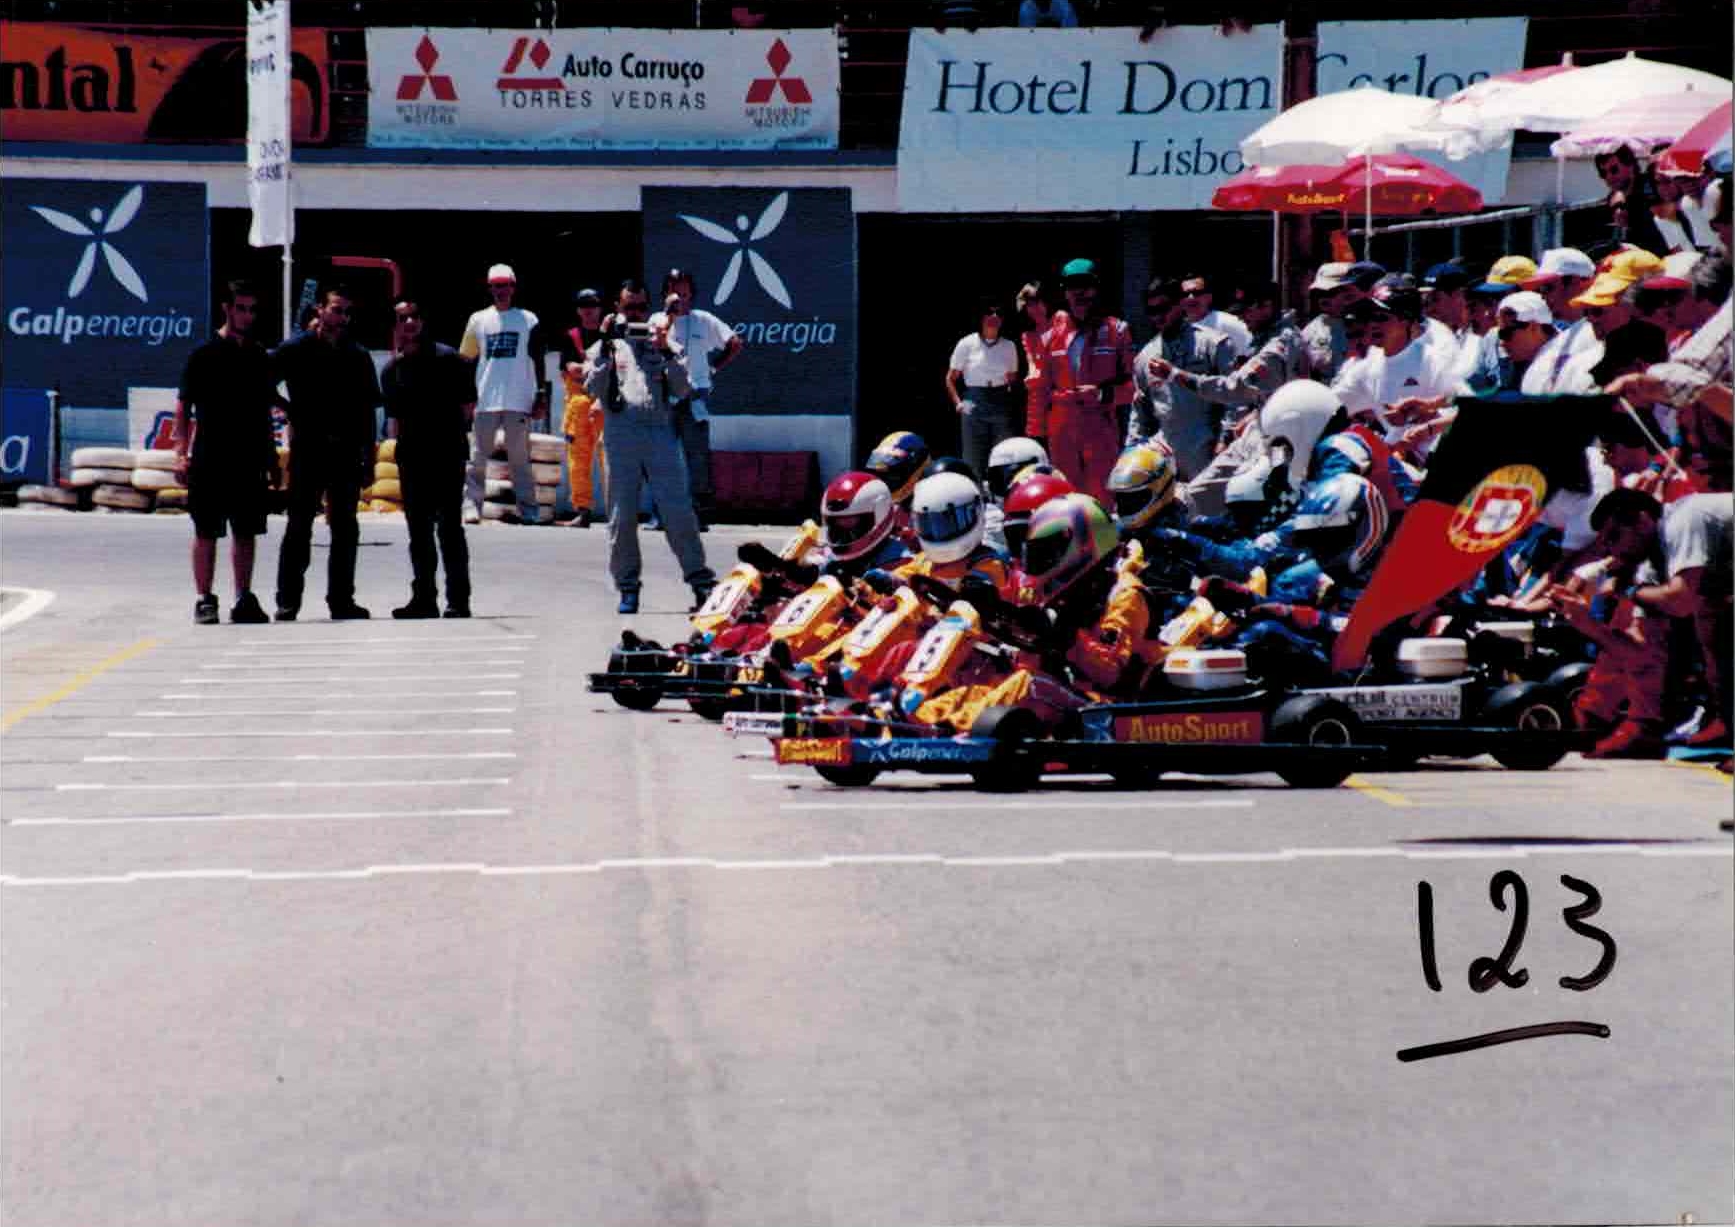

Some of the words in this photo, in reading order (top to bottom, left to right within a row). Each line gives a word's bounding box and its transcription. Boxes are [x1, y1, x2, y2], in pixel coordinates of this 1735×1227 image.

[0, 46, 137, 113] ntal
[563, 53, 613, 79] Auto
[620, 52, 705, 88] Carruço
[929, 59, 1091, 115] Hotel
[1116, 60, 1276, 115] Dom
[500, 90, 593, 109] TORRES
[612, 91, 706, 110] VEDRAS
[1128, 138, 1255, 176] Lisbo
[8, 307, 192, 345] Galpenergia
[1131, 714, 1252, 742] AutoSport
